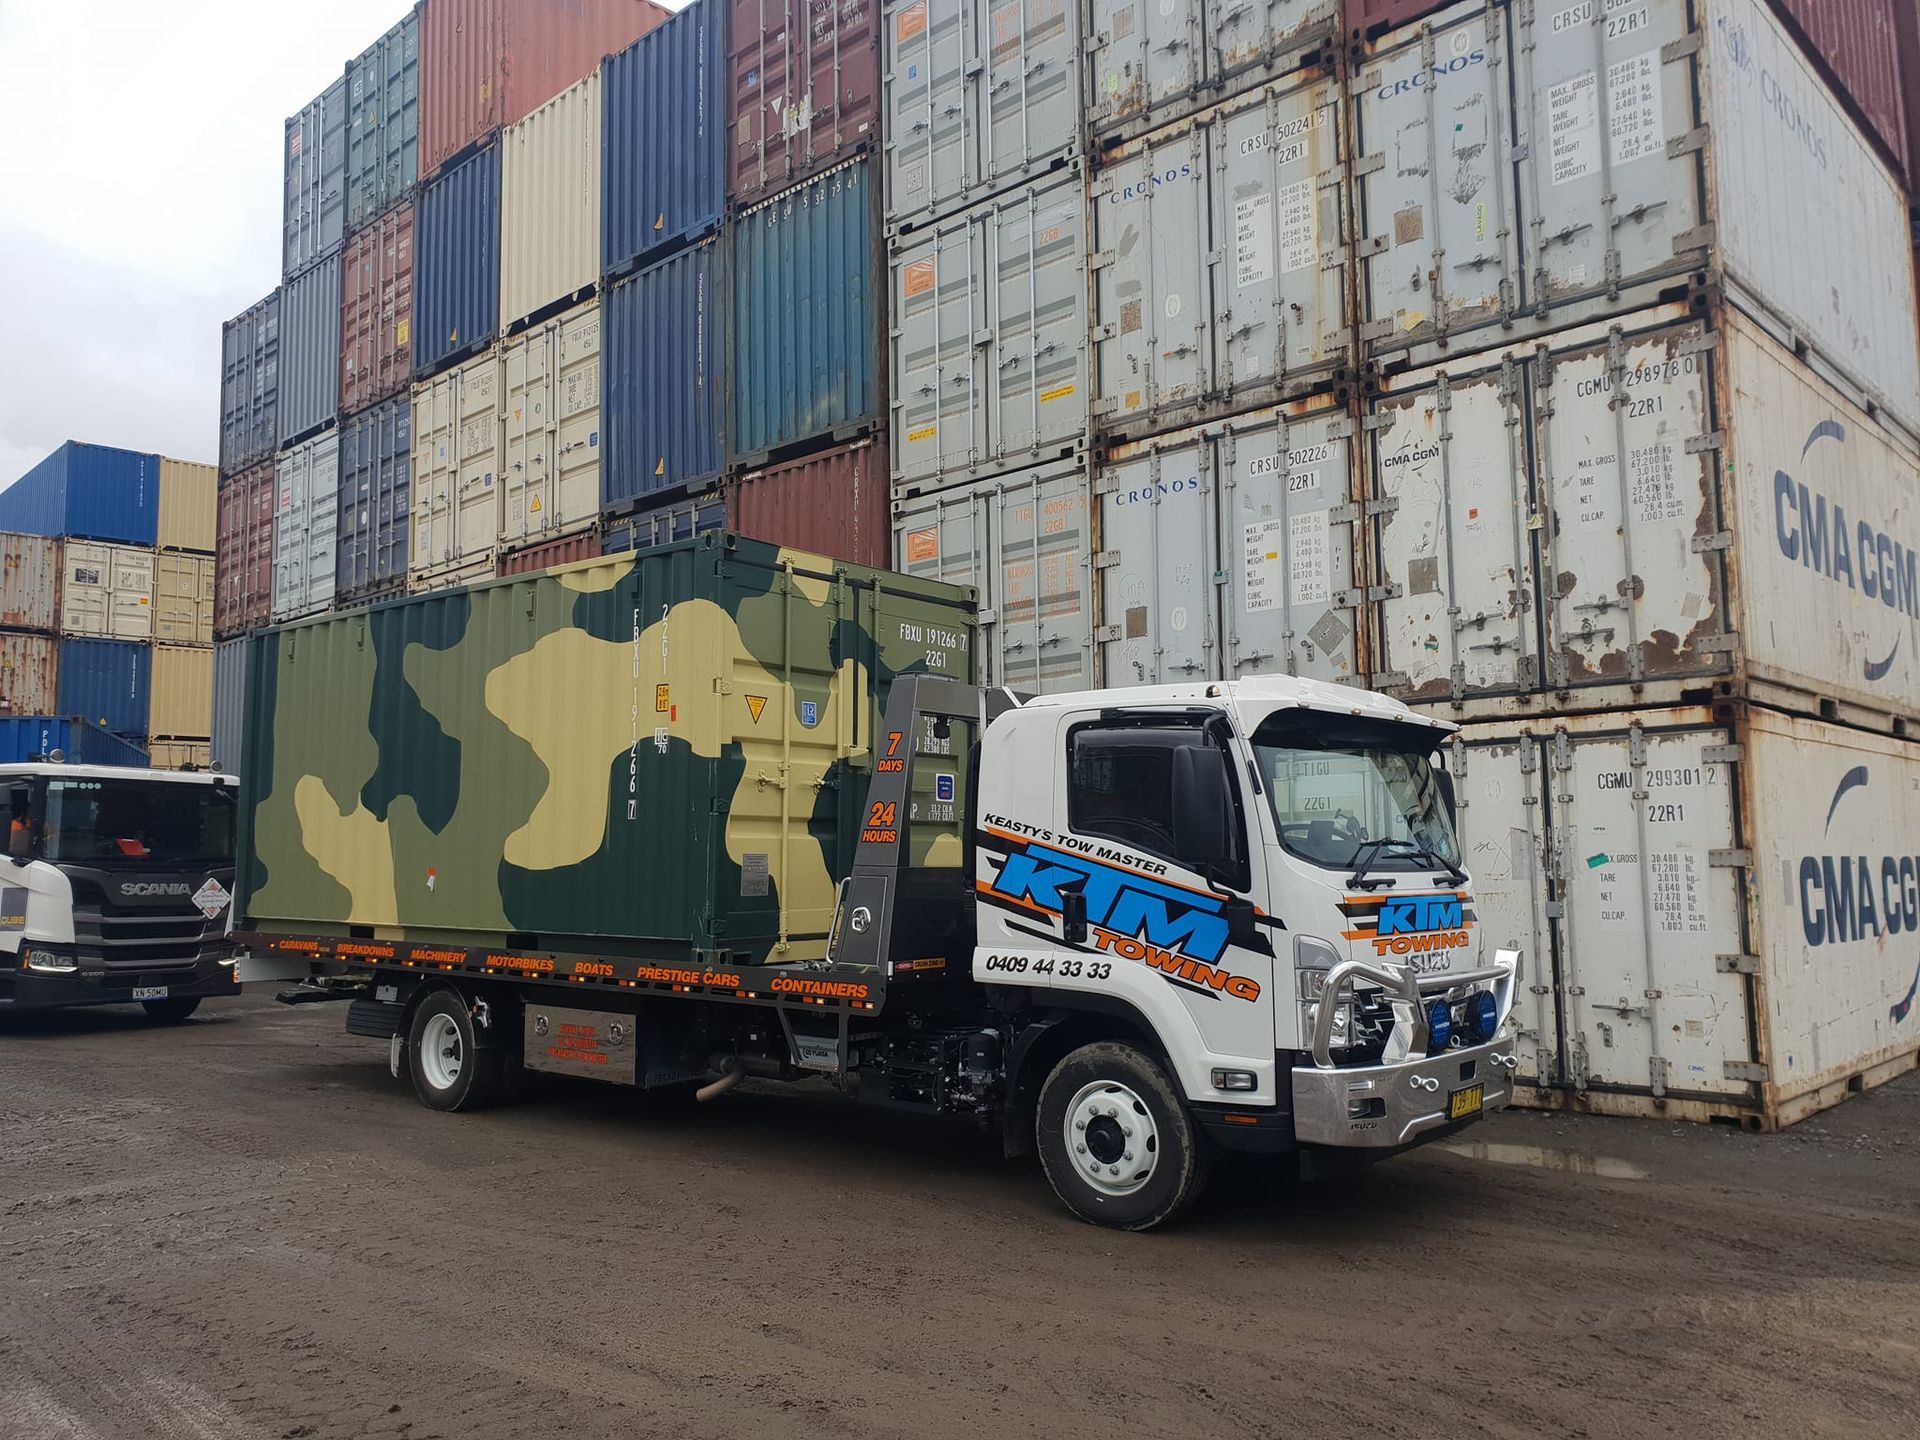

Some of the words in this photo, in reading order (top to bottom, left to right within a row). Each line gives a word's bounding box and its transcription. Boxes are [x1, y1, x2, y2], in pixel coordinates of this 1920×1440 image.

[1553, 3, 1591, 31] CRSU
[1608, 8, 1647, 38] 22R1
[1378, 49, 1486, 100] CRONOS
[1572, 75, 1595, 91] GROSS
[1551, 92, 1578, 108] WEIGHT
[1553, 116, 1578, 132] WEIGHT
[1762, 68, 1827, 170] CRONOS
[1240, 133, 1269, 155] CRSU
[1278, 117, 1314, 140] 502241
[1318, 110, 1325, 126] 5
[1279, 143, 1304, 164] 22R1
[1554, 140, 1580, 156] WEIGHT
[1555, 162, 1587, 182] CAPACITY
[1110, 164, 1191, 204] CRONOS
[1576, 375, 1611, 398] CGMU
[1625, 361, 1680, 388] 298978
[1628, 395, 1663, 418] 22R1
[1250, 454, 1279, 476] CRSU
[1288, 446, 1328, 467] 502226
[1384, 454, 1411, 468] CMA
[1412, 447, 1440, 462] CGM
[1595, 454, 1616, 466] GROSS
[1631, 446, 1659, 459] 30.480
[1631, 455, 1660, 468] 67.200
[1637, 464, 1660, 476] 3.010
[1637, 474, 1660, 486] 6.640
[1116, 476, 1198, 506] CRONOS
[1289, 472, 1315, 492] 22R1
[1580, 476, 1594, 487] TARE
[1580, 495, 1592, 504] NET
[1633, 492, 1662, 505] 60.560
[1640, 511, 1663, 522] 1.003
[1774, 470, 1856, 589] CMA
[1857, 520, 1920, 620] CGM
[632, 608, 640, 679] FBXU
[661, 604, 669, 675] 22G1
[900, 623, 922, 642] FBXU
[926, 628, 956, 649] 191266
[960, 634, 967, 651] 7
[926, 650, 946, 668] 22G1
[629, 686, 639, 793] 191266
[887, 732, 902, 757] 7
[877, 759, 904, 772] DAYS
[1598, 771, 1633, 790] CGMU
[1647, 768, 1701, 788] 299301
[1707, 767, 1717, 785] 2
[868, 801, 896, 827] 24
[1304, 797, 1331, 811] 22G1
[1648, 804, 1684, 822] 22R1
[862, 829, 897, 843] HOURS
[984, 812, 1052, 841] KEASTY'S
[1057, 834, 1094, 853] TOW
[1096, 846, 1168, 876] MASTER
[1651, 854, 1678, 863] 30.480
[1652, 864, 1679, 873] 67.200
[1600, 873, 1616, 882] TARE
[1658, 874, 1679, 882] 3.010
[1658, 883, 1680, 892] 6.640
[120, 882, 191, 896] SCANIA
[1600, 892, 1612, 901] NET
[1654, 893, 1681, 902] 27.470
[994, 842, 1230, 965] KTM
[1654, 902, 1681, 911] 60.560
[1800, 856, 1880, 946] CMA
[1882, 856, 1920, 935] CG
[1376, 894, 1463, 936] KTM
[1662, 922, 1682, 931] 1.003
[1372, 931, 1469, 956] TOWING
[279, 939, 319, 951] CARAVANS
[336, 943, 395, 957] BREAKDOWNS
[410, 949, 467, 963] MACHINERY
[486, 955, 554, 971] MOTORBIKES
[575, 962, 614, 977] BOATS
[637, 966, 699, 984] PRESTIGE
[703, 971, 741, 988] CARS
[771, 977, 869, 999] CONTAINERS
[986, 954, 1028, 973] 0409
[1032, 959, 1055, 975] 44
[1059, 961, 1082, 977] 33
[1087, 962, 1112, 979] 33
[1092, 928, 1261, 1003] TOWING
